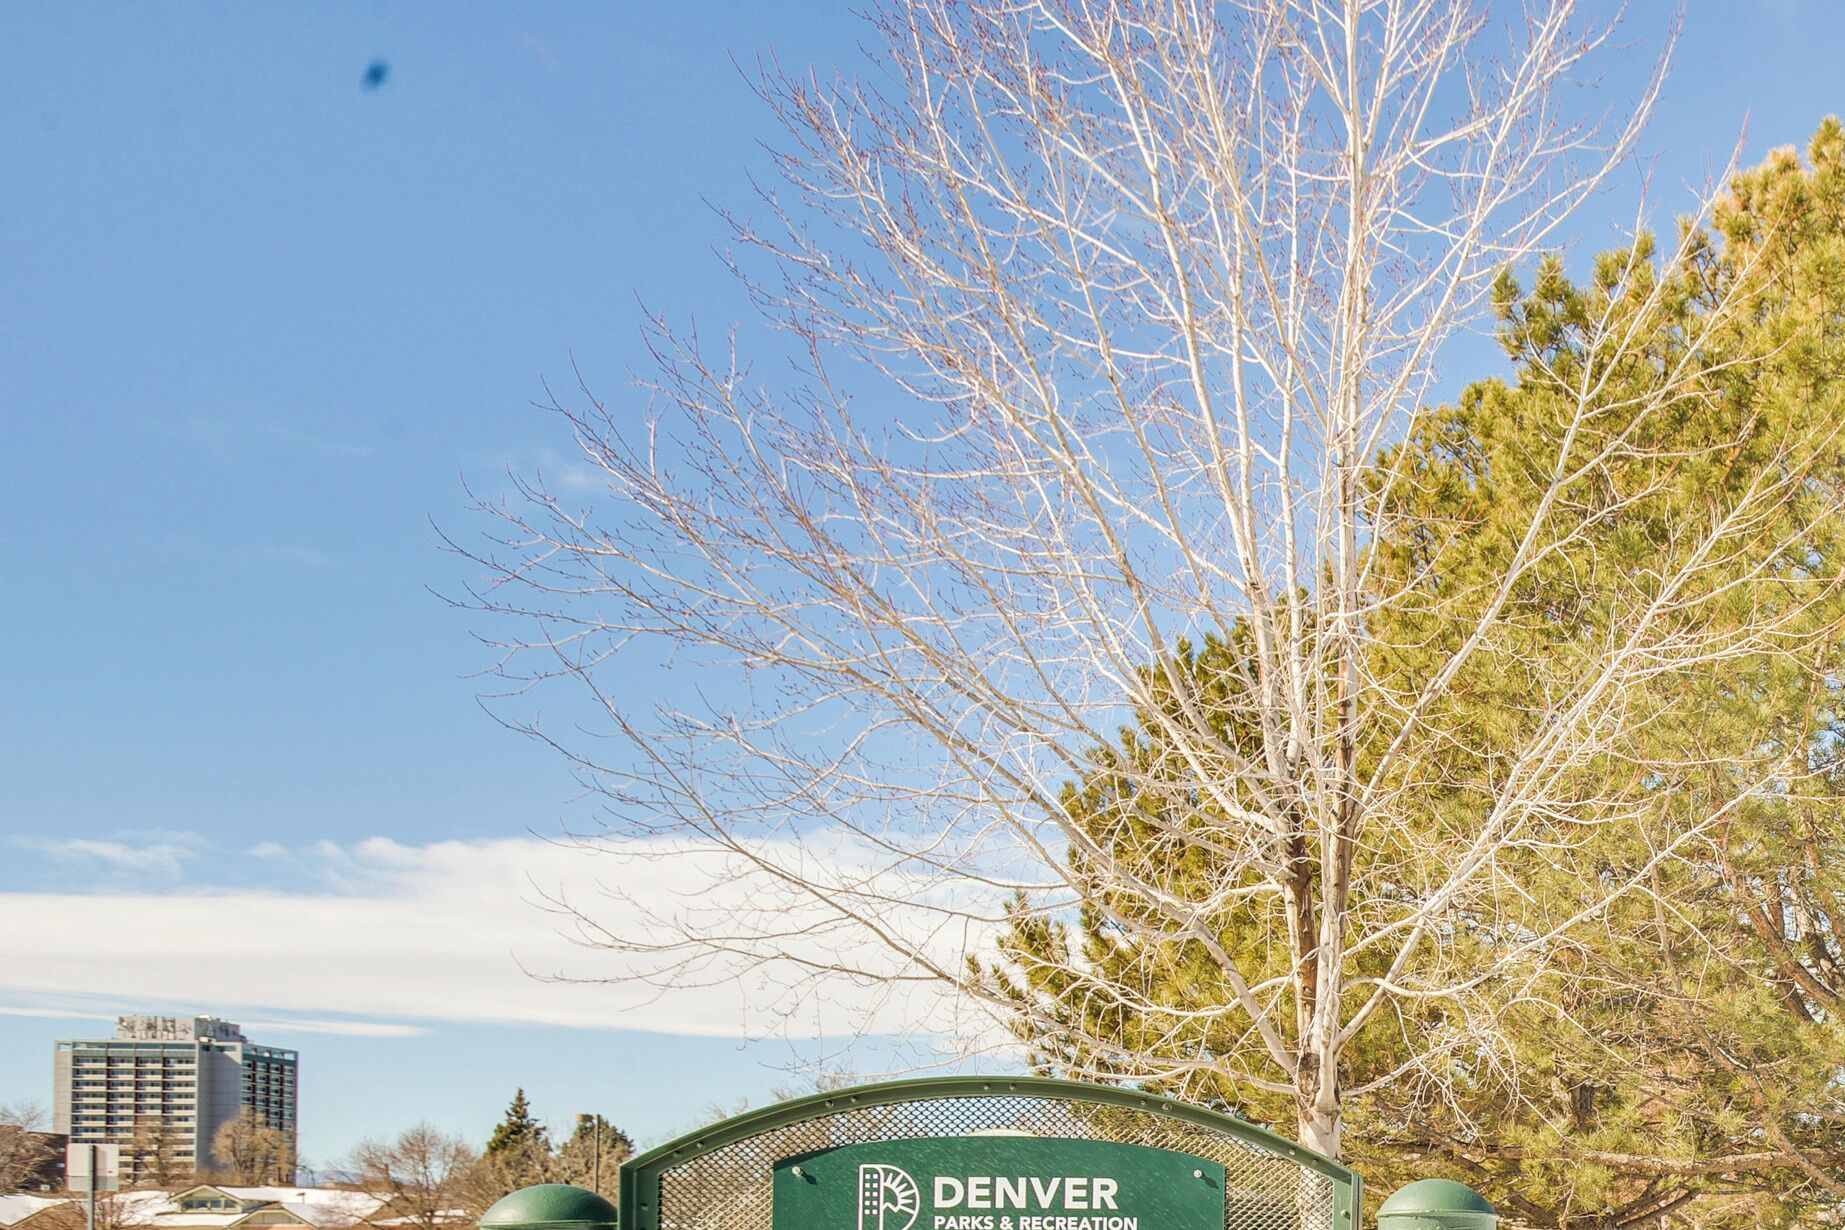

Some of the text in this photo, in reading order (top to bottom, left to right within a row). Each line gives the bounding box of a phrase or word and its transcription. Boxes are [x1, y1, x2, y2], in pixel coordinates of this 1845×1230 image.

[933, 1176, 1119, 1210] DENVER
[933, 1215, 994, 1230] PARKS
[999, 1216, 1014, 1230] &
